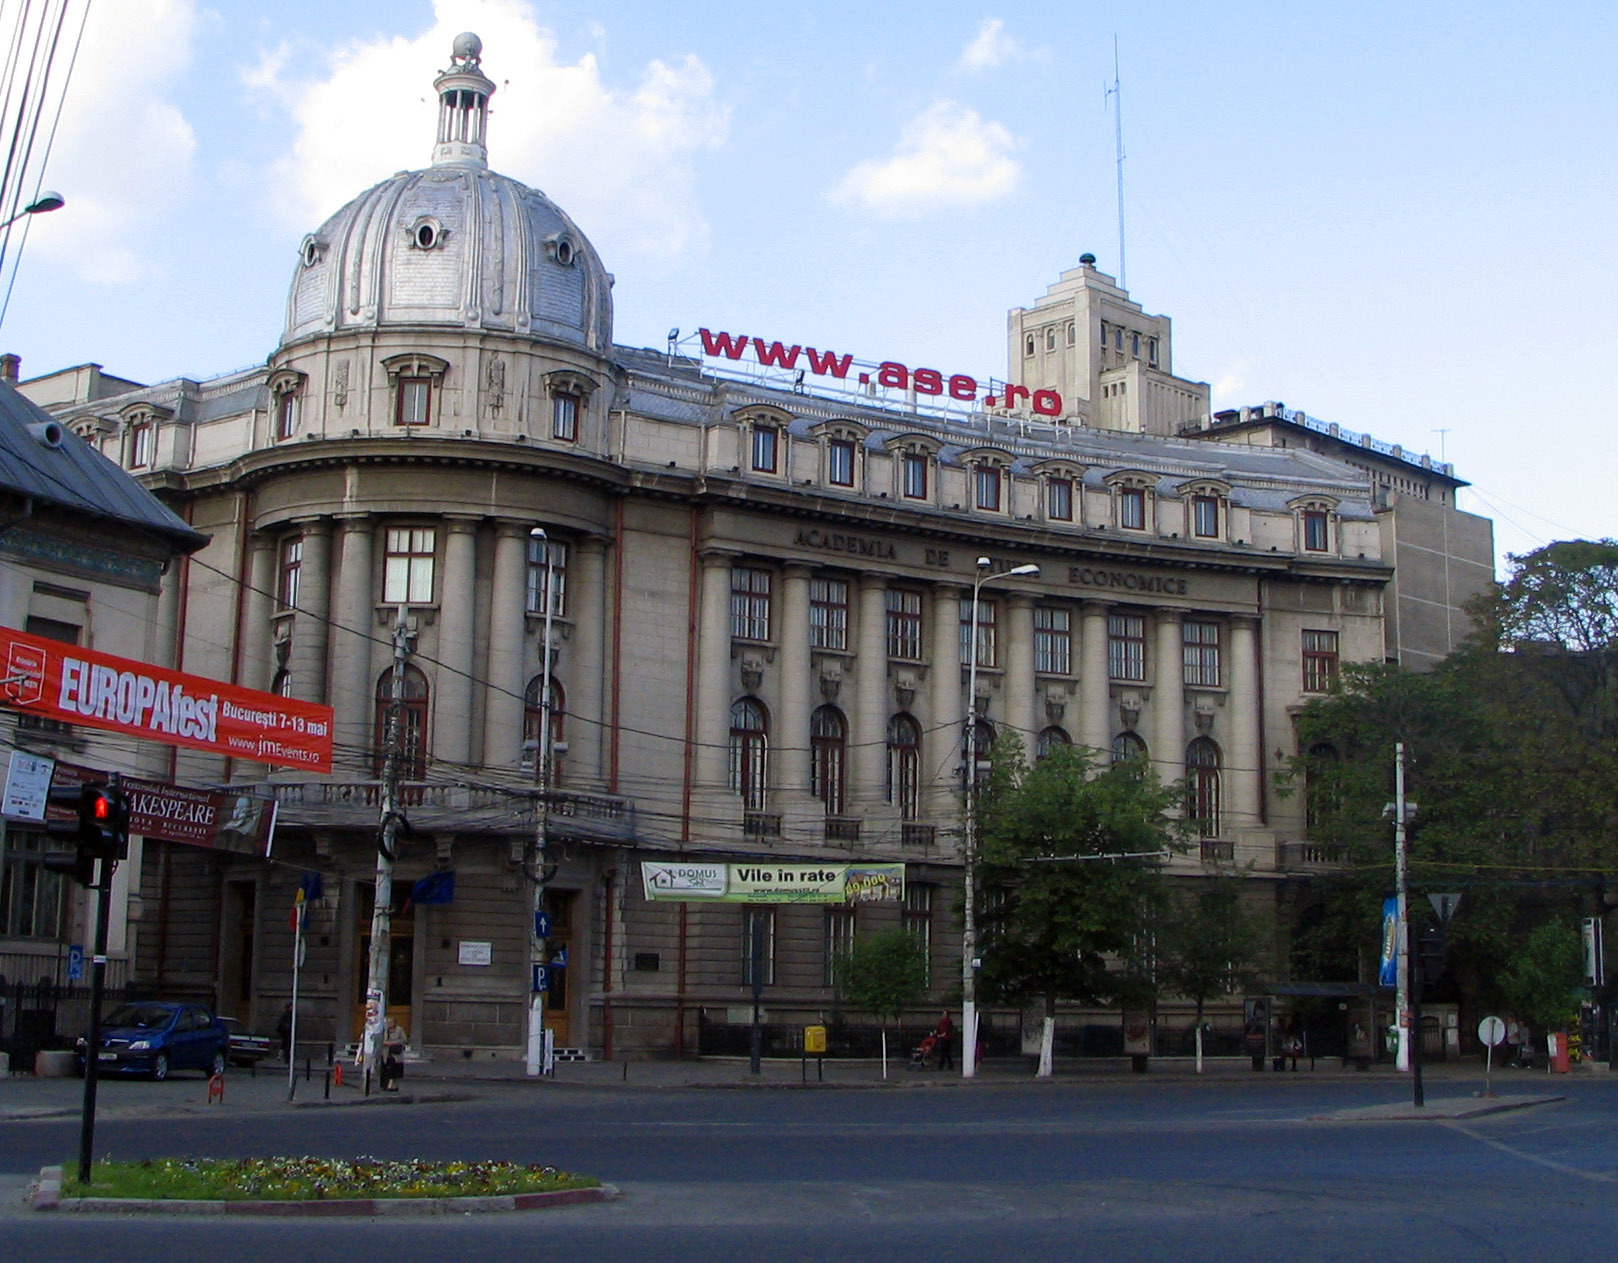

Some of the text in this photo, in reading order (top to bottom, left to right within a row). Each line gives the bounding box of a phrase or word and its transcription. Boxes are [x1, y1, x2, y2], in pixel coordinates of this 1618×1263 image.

[699, 327, 1062, 417] www.ase.ro
[793, 527, 898, 560] ACADEMIA
[925, 548, 949, 567] DE
[1068, 567, 1188, 595] ECONOMICE
[58, 656, 218, 743] EUROPAfest
[280, 713, 304, 733] 7-13
[307, 721, 328, 736] mai
[125, 791, 216, 825] AKESPEARE
[678, 869, 717, 879] DOMUS
[737, 868, 836, 883] Vile în rate
[537, 967, 545, 987] P
